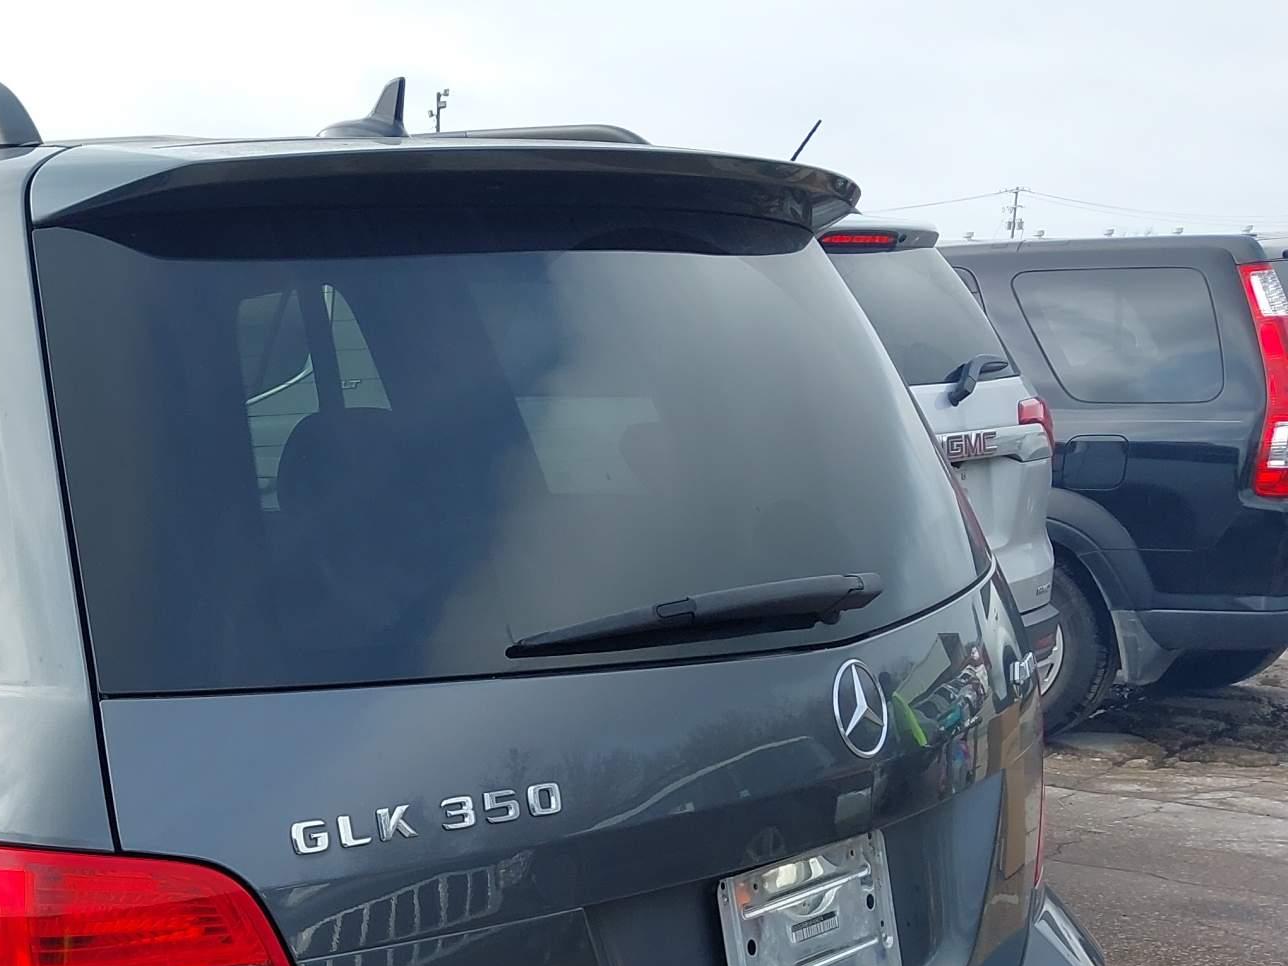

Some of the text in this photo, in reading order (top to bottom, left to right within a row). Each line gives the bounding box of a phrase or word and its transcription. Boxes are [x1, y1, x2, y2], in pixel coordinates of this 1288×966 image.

[947, 431, 998, 459] GMC
[290, 782, 563, 856] GLK 350
